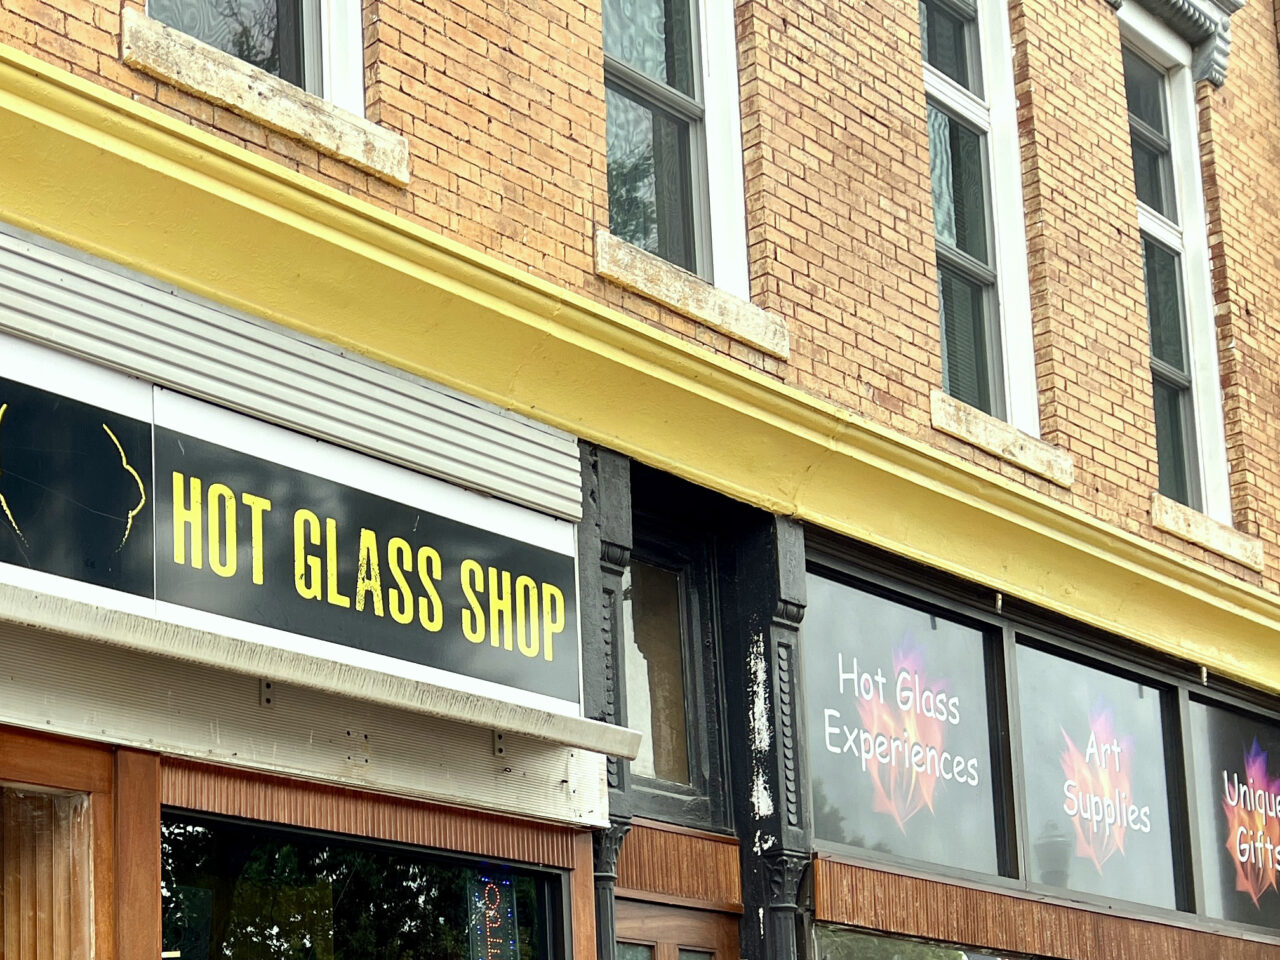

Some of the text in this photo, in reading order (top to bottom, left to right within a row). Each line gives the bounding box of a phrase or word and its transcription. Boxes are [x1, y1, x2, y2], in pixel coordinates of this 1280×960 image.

[171, 471, 566, 662] HOT GLASS SHOP
[838, 653, 960, 725] Hot Glass
[824, 708, 979, 786] Experiences
[1086, 731, 1121, 772] Art
[1063, 779, 1150, 835] Supplies
